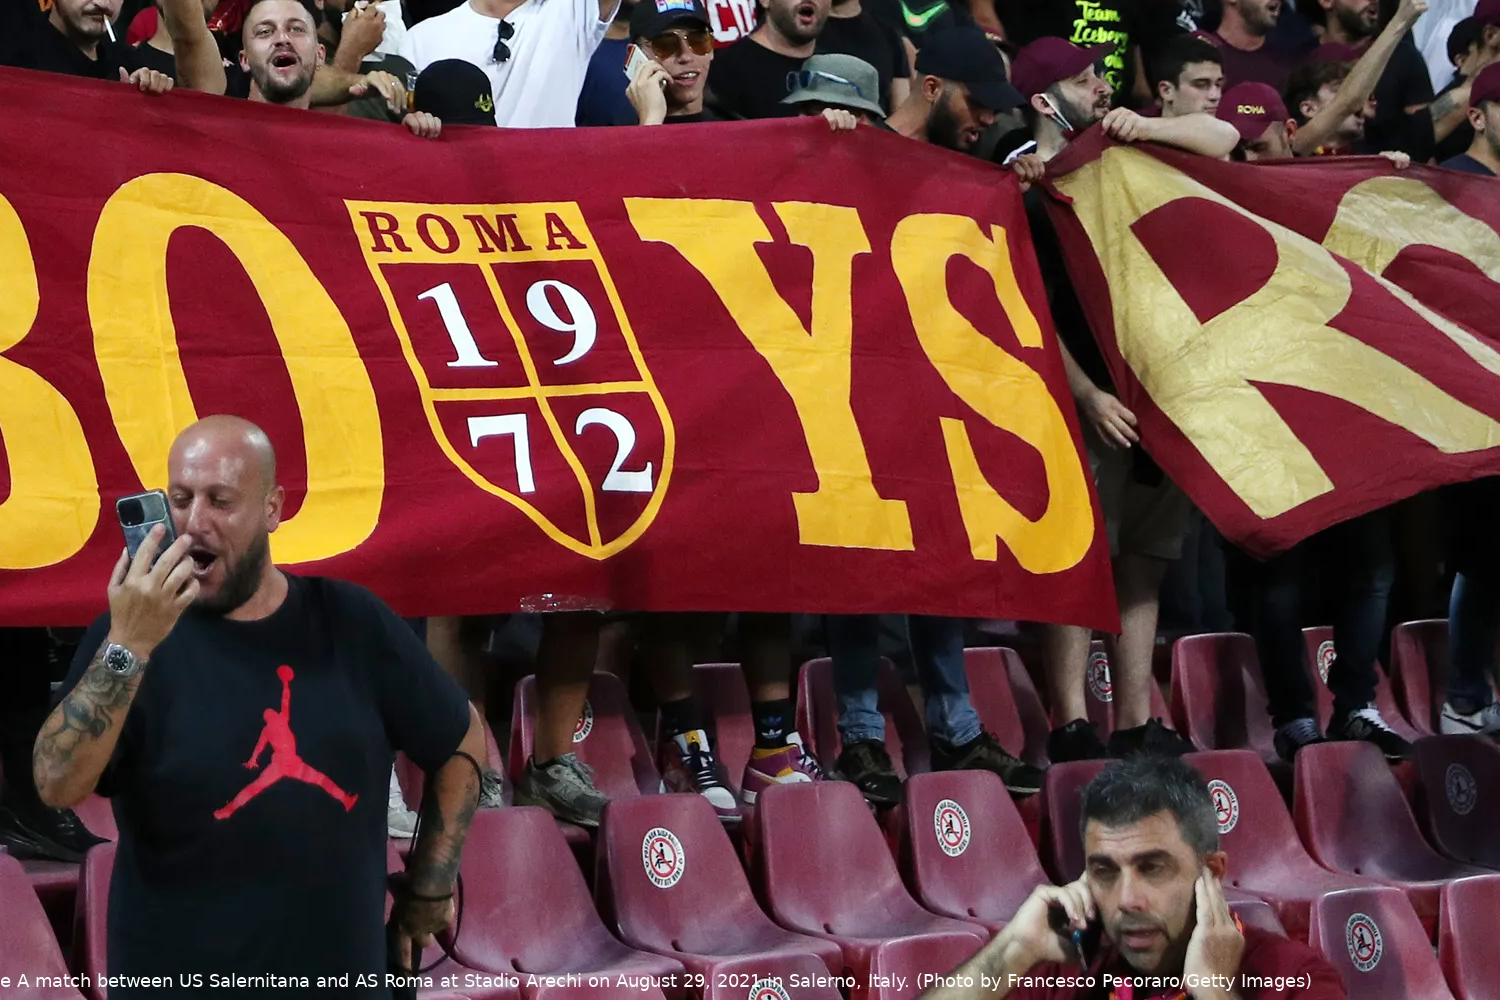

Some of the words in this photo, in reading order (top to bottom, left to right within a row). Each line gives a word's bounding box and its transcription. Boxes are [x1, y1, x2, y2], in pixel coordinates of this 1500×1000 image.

[1075, 0, 1121, 22] Team
[1237, 105, 1265, 115] ROMA
[359, 210, 586, 254] ROMA
